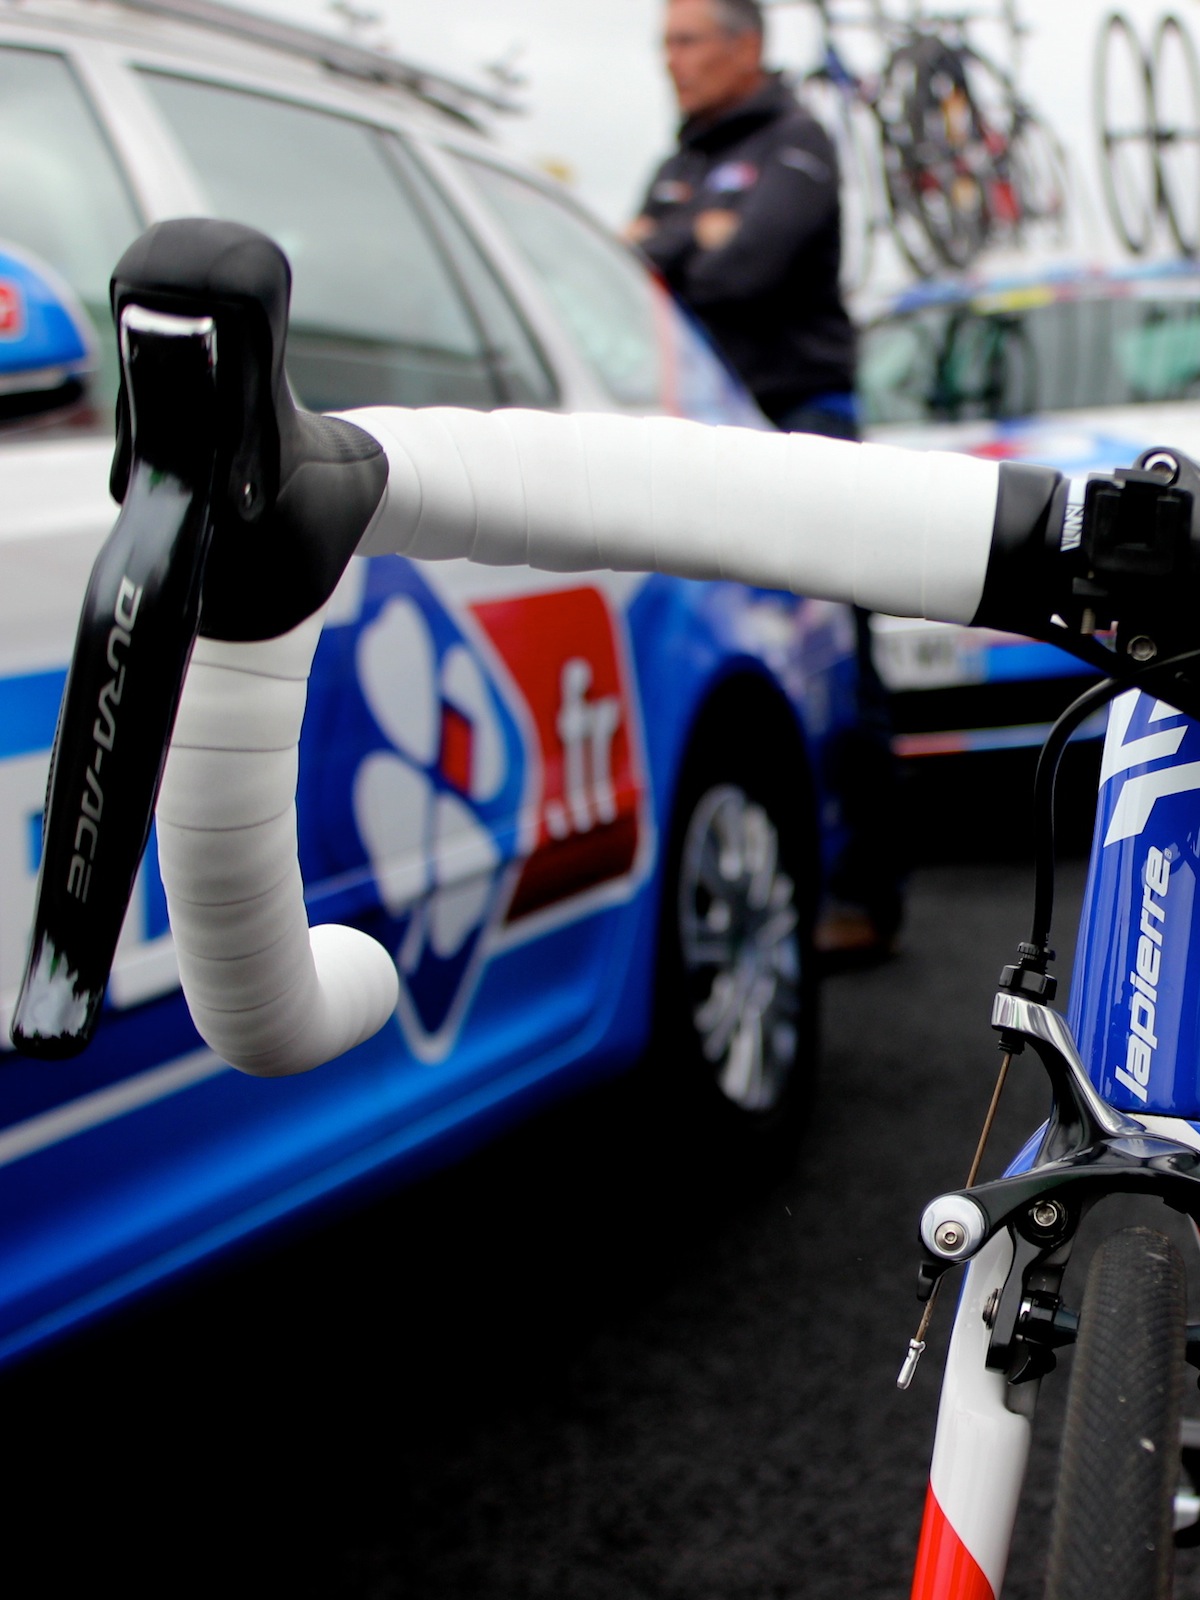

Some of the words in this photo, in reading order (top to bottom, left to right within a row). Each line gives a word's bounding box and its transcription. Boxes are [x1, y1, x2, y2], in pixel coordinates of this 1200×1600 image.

[67, 574, 143, 903] DURA-ACE
[544, 655, 621, 840] .fr
[1115, 846, 1171, 1103] lapierre
